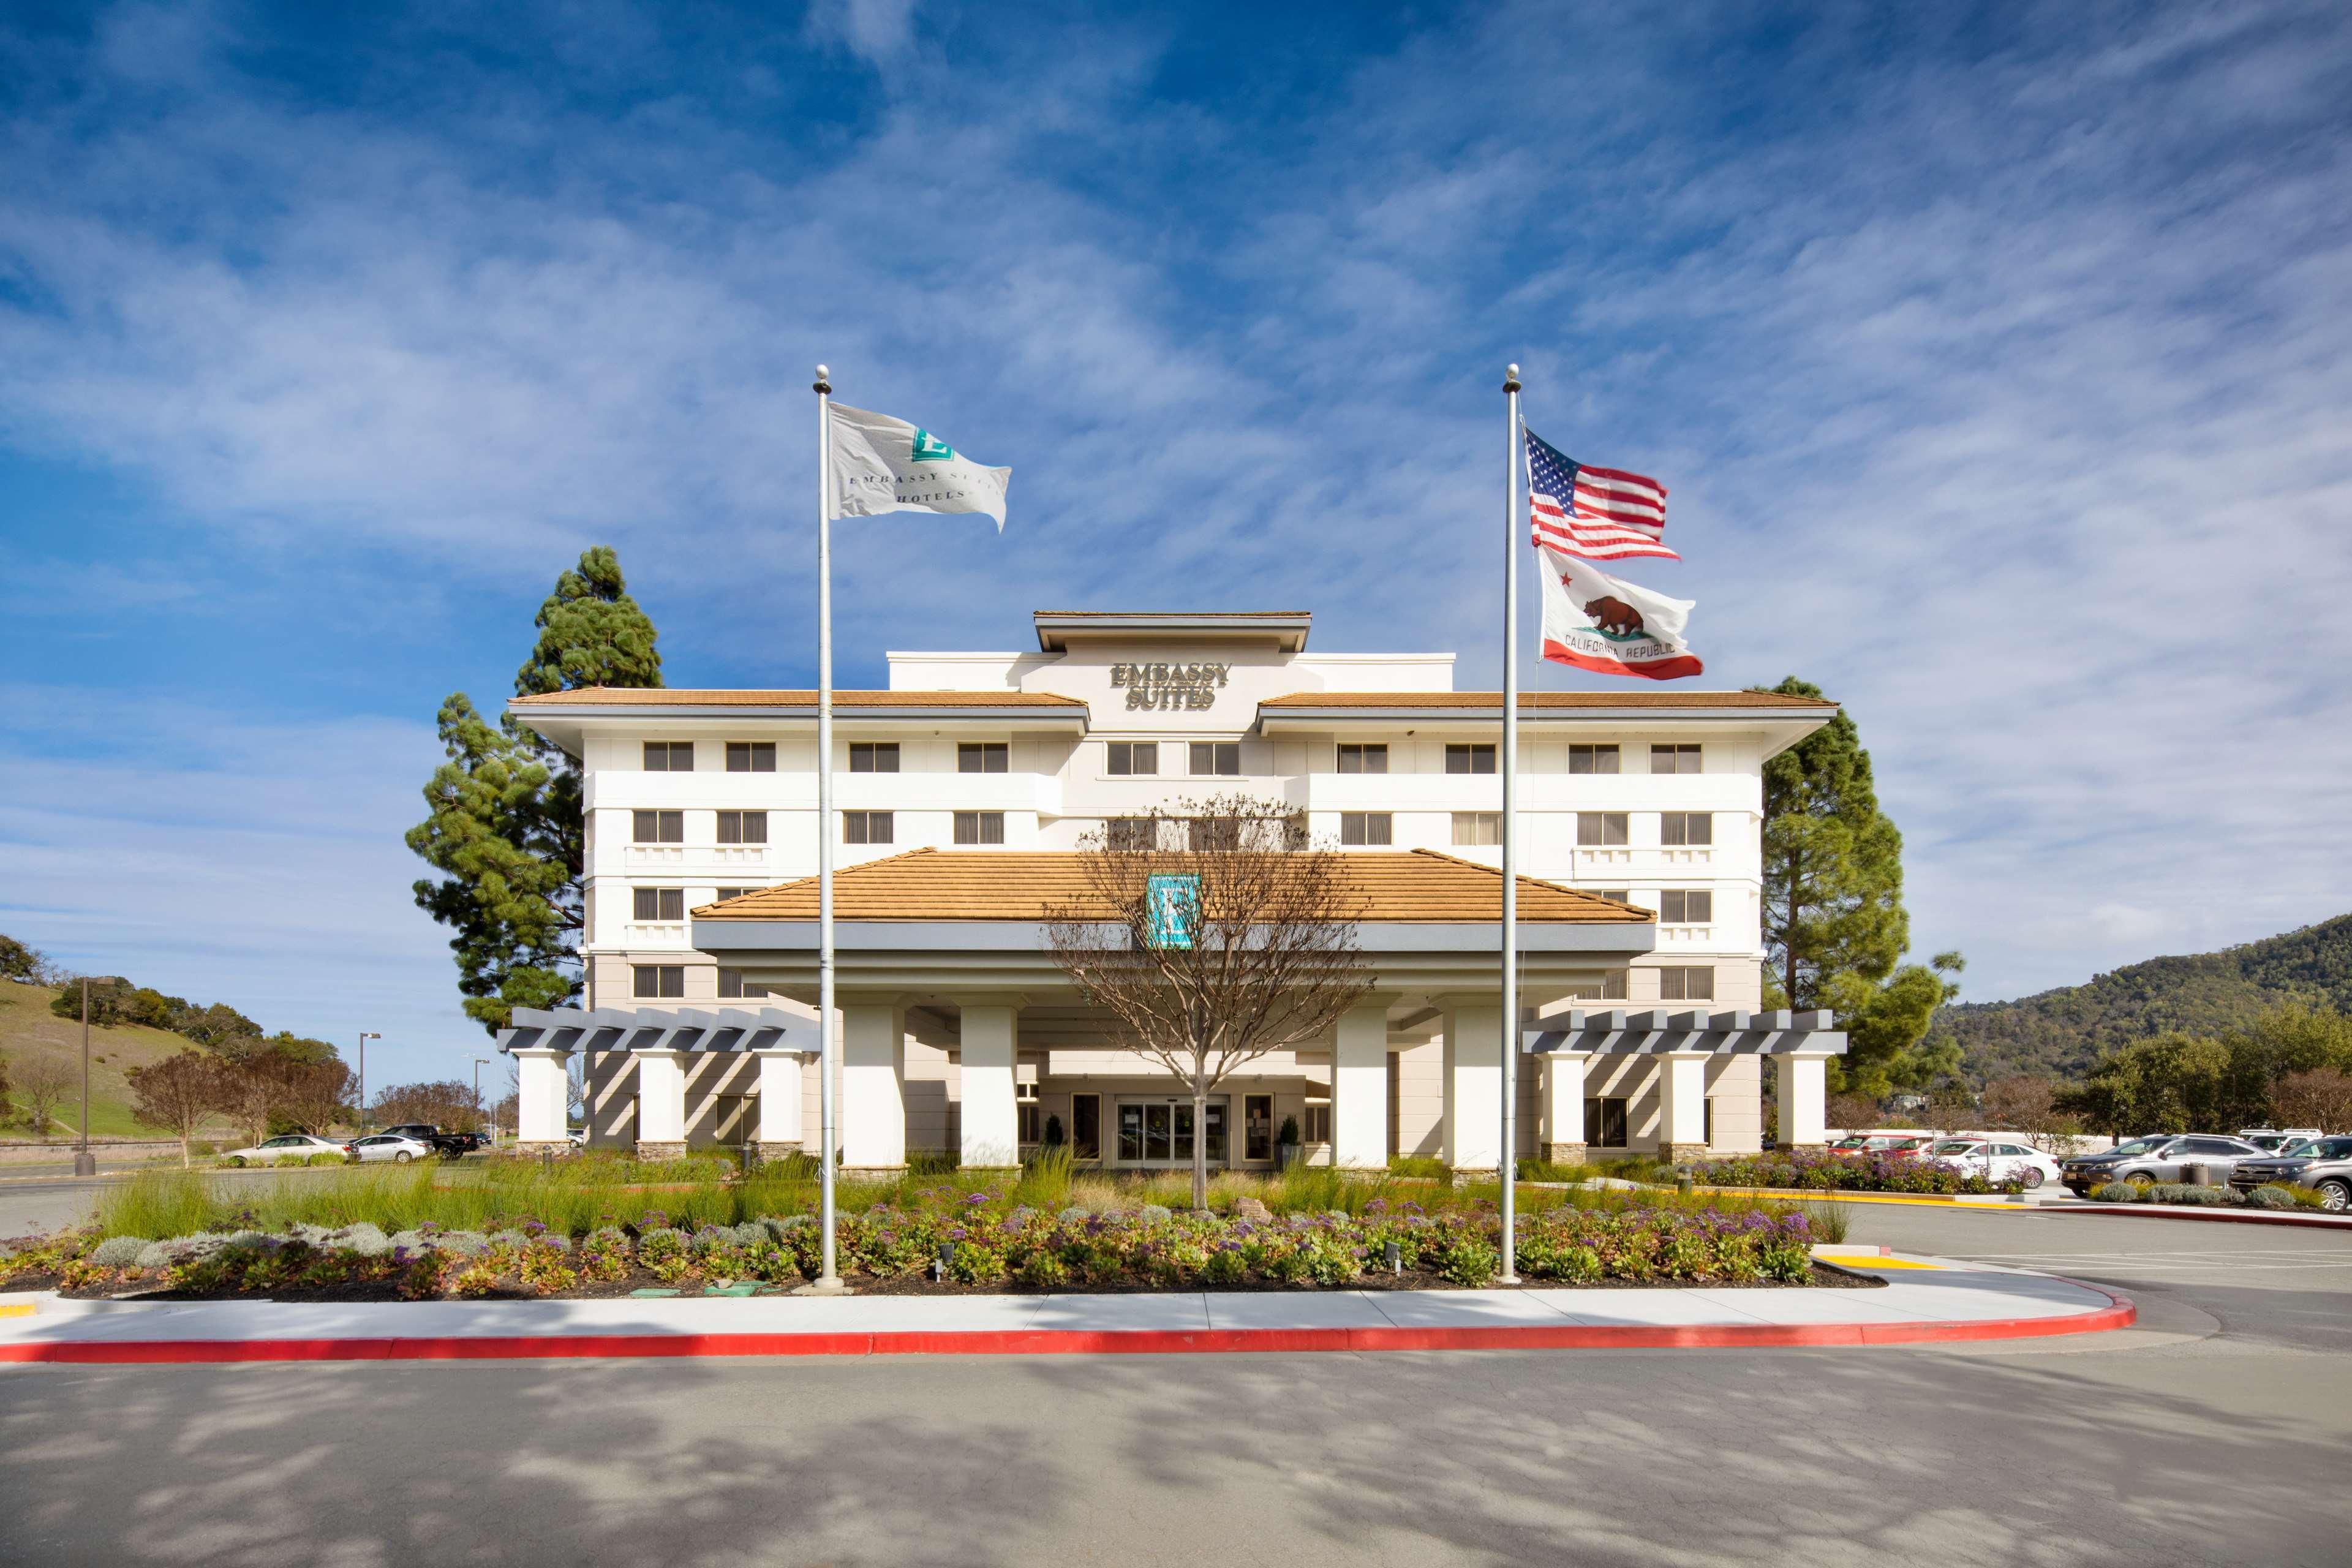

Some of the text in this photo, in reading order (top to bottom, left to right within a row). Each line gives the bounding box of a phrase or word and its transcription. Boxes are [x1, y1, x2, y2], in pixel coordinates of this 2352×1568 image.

[850, 473, 937, 484] EMBASSY
[897, 491, 964, 502] HOTELS
[1565, 634, 1675, 658] CALIFORNIA REPUBLIC
[1112, 662, 1232, 684] EMBASSY
[1128, 685, 1216, 706] SUITES
